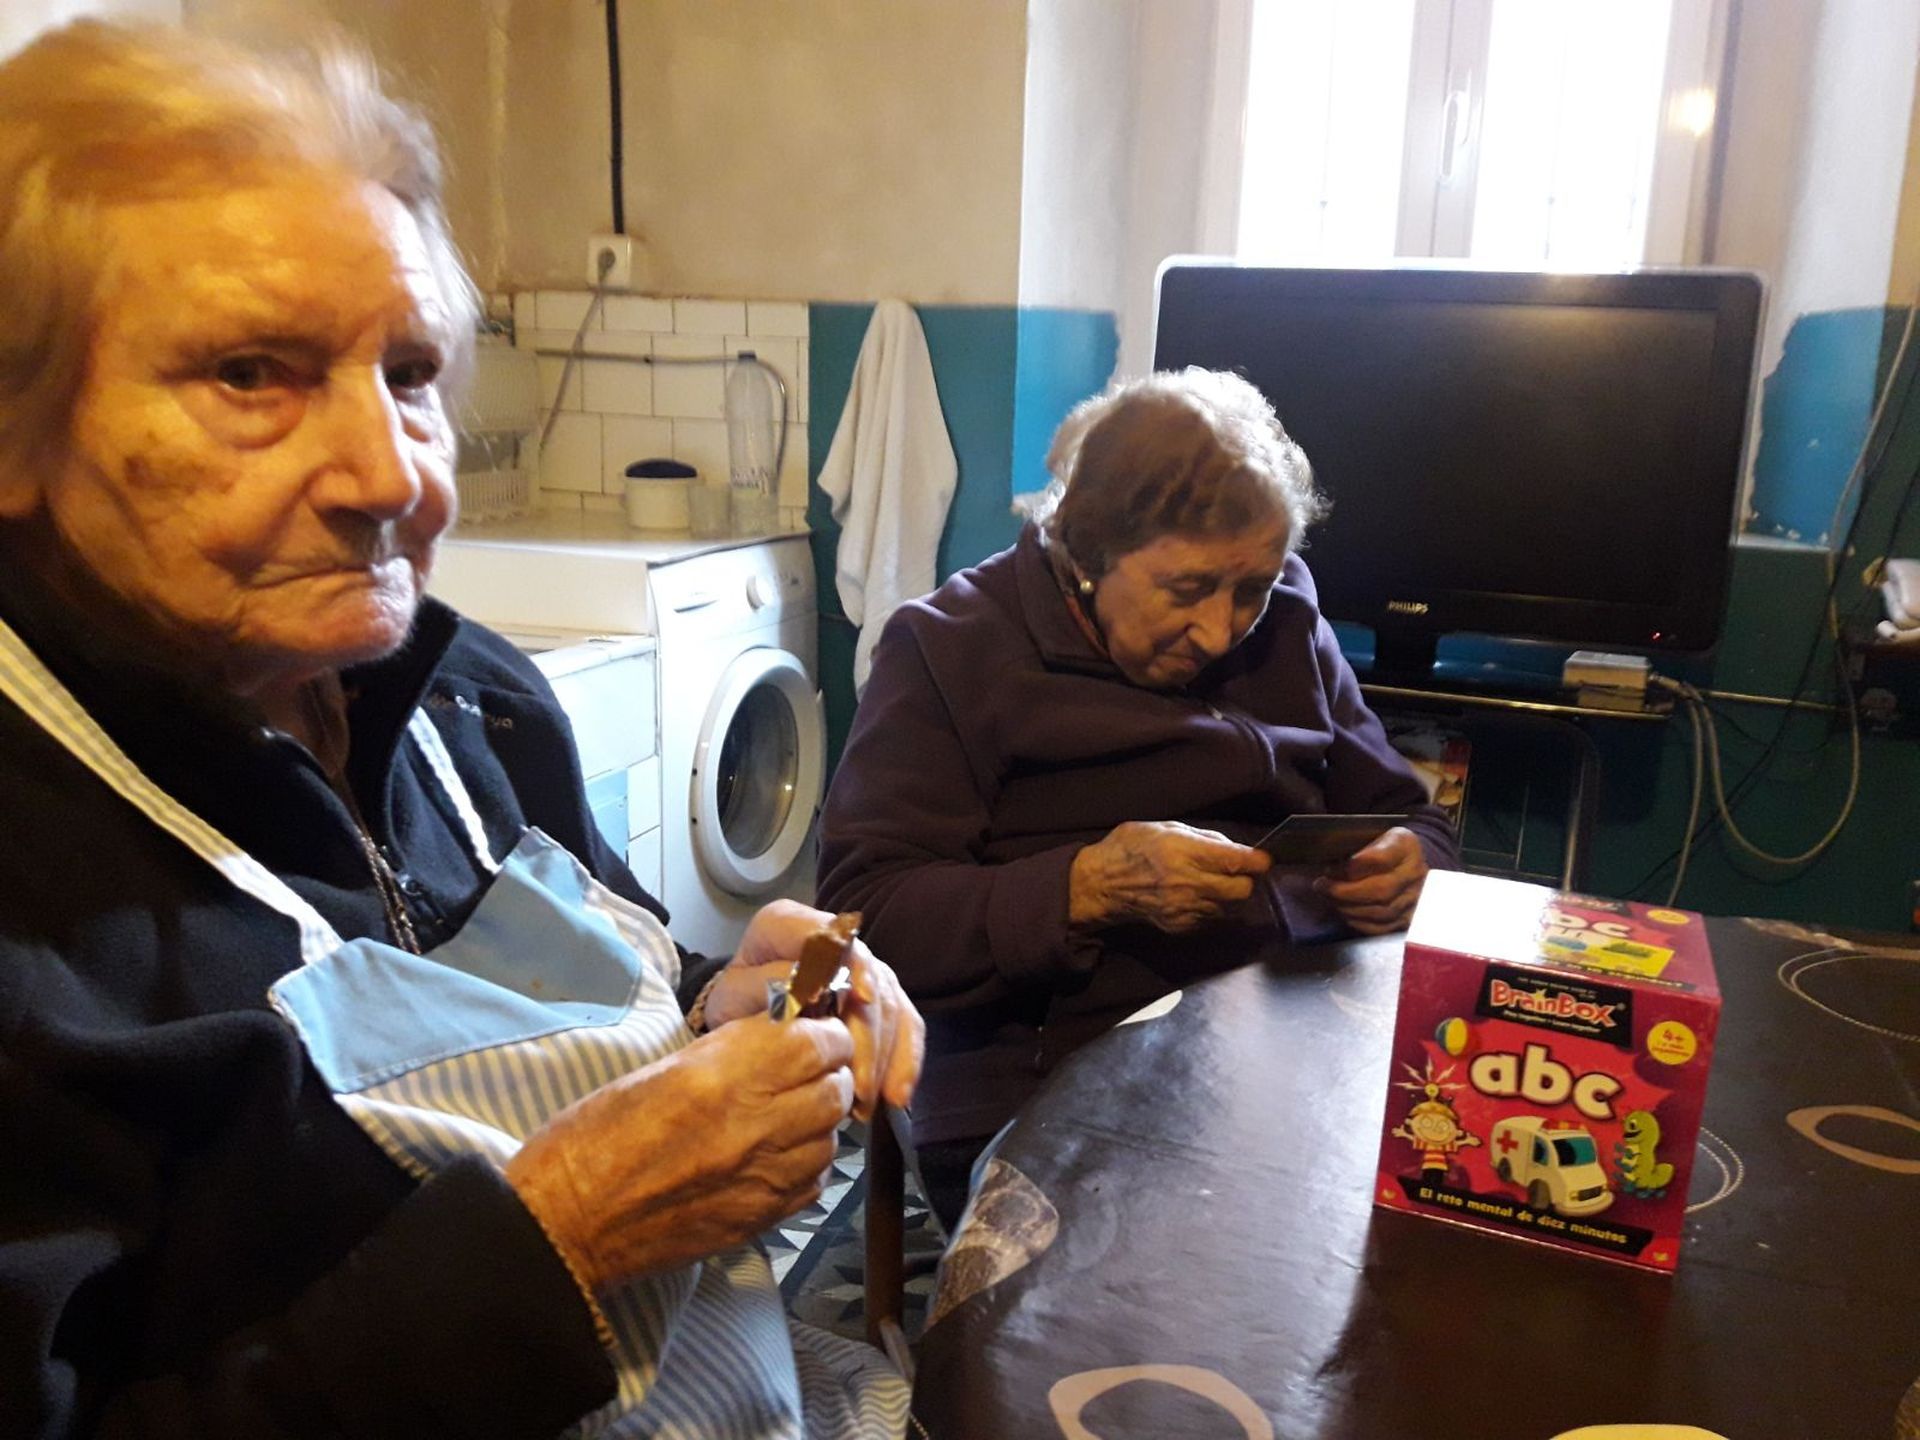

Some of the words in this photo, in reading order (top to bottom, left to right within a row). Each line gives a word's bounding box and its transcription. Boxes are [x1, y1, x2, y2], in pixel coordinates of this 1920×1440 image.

[1388, 600, 1430, 615] PHILIPS
[1490, 979, 1618, 1028] BrainBox
[1469, 1042, 1624, 1120] abc
[1420, 1187, 1433, 1199] El
[1436, 1193, 1463, 1206] reto
[1467, 1200, 1513, 1218] mental
[1516, 1210, 1533, 1222] de
[1537, 1215, 1565, 1230] diez
[1569, 1224, 1627, 1244] minutos
